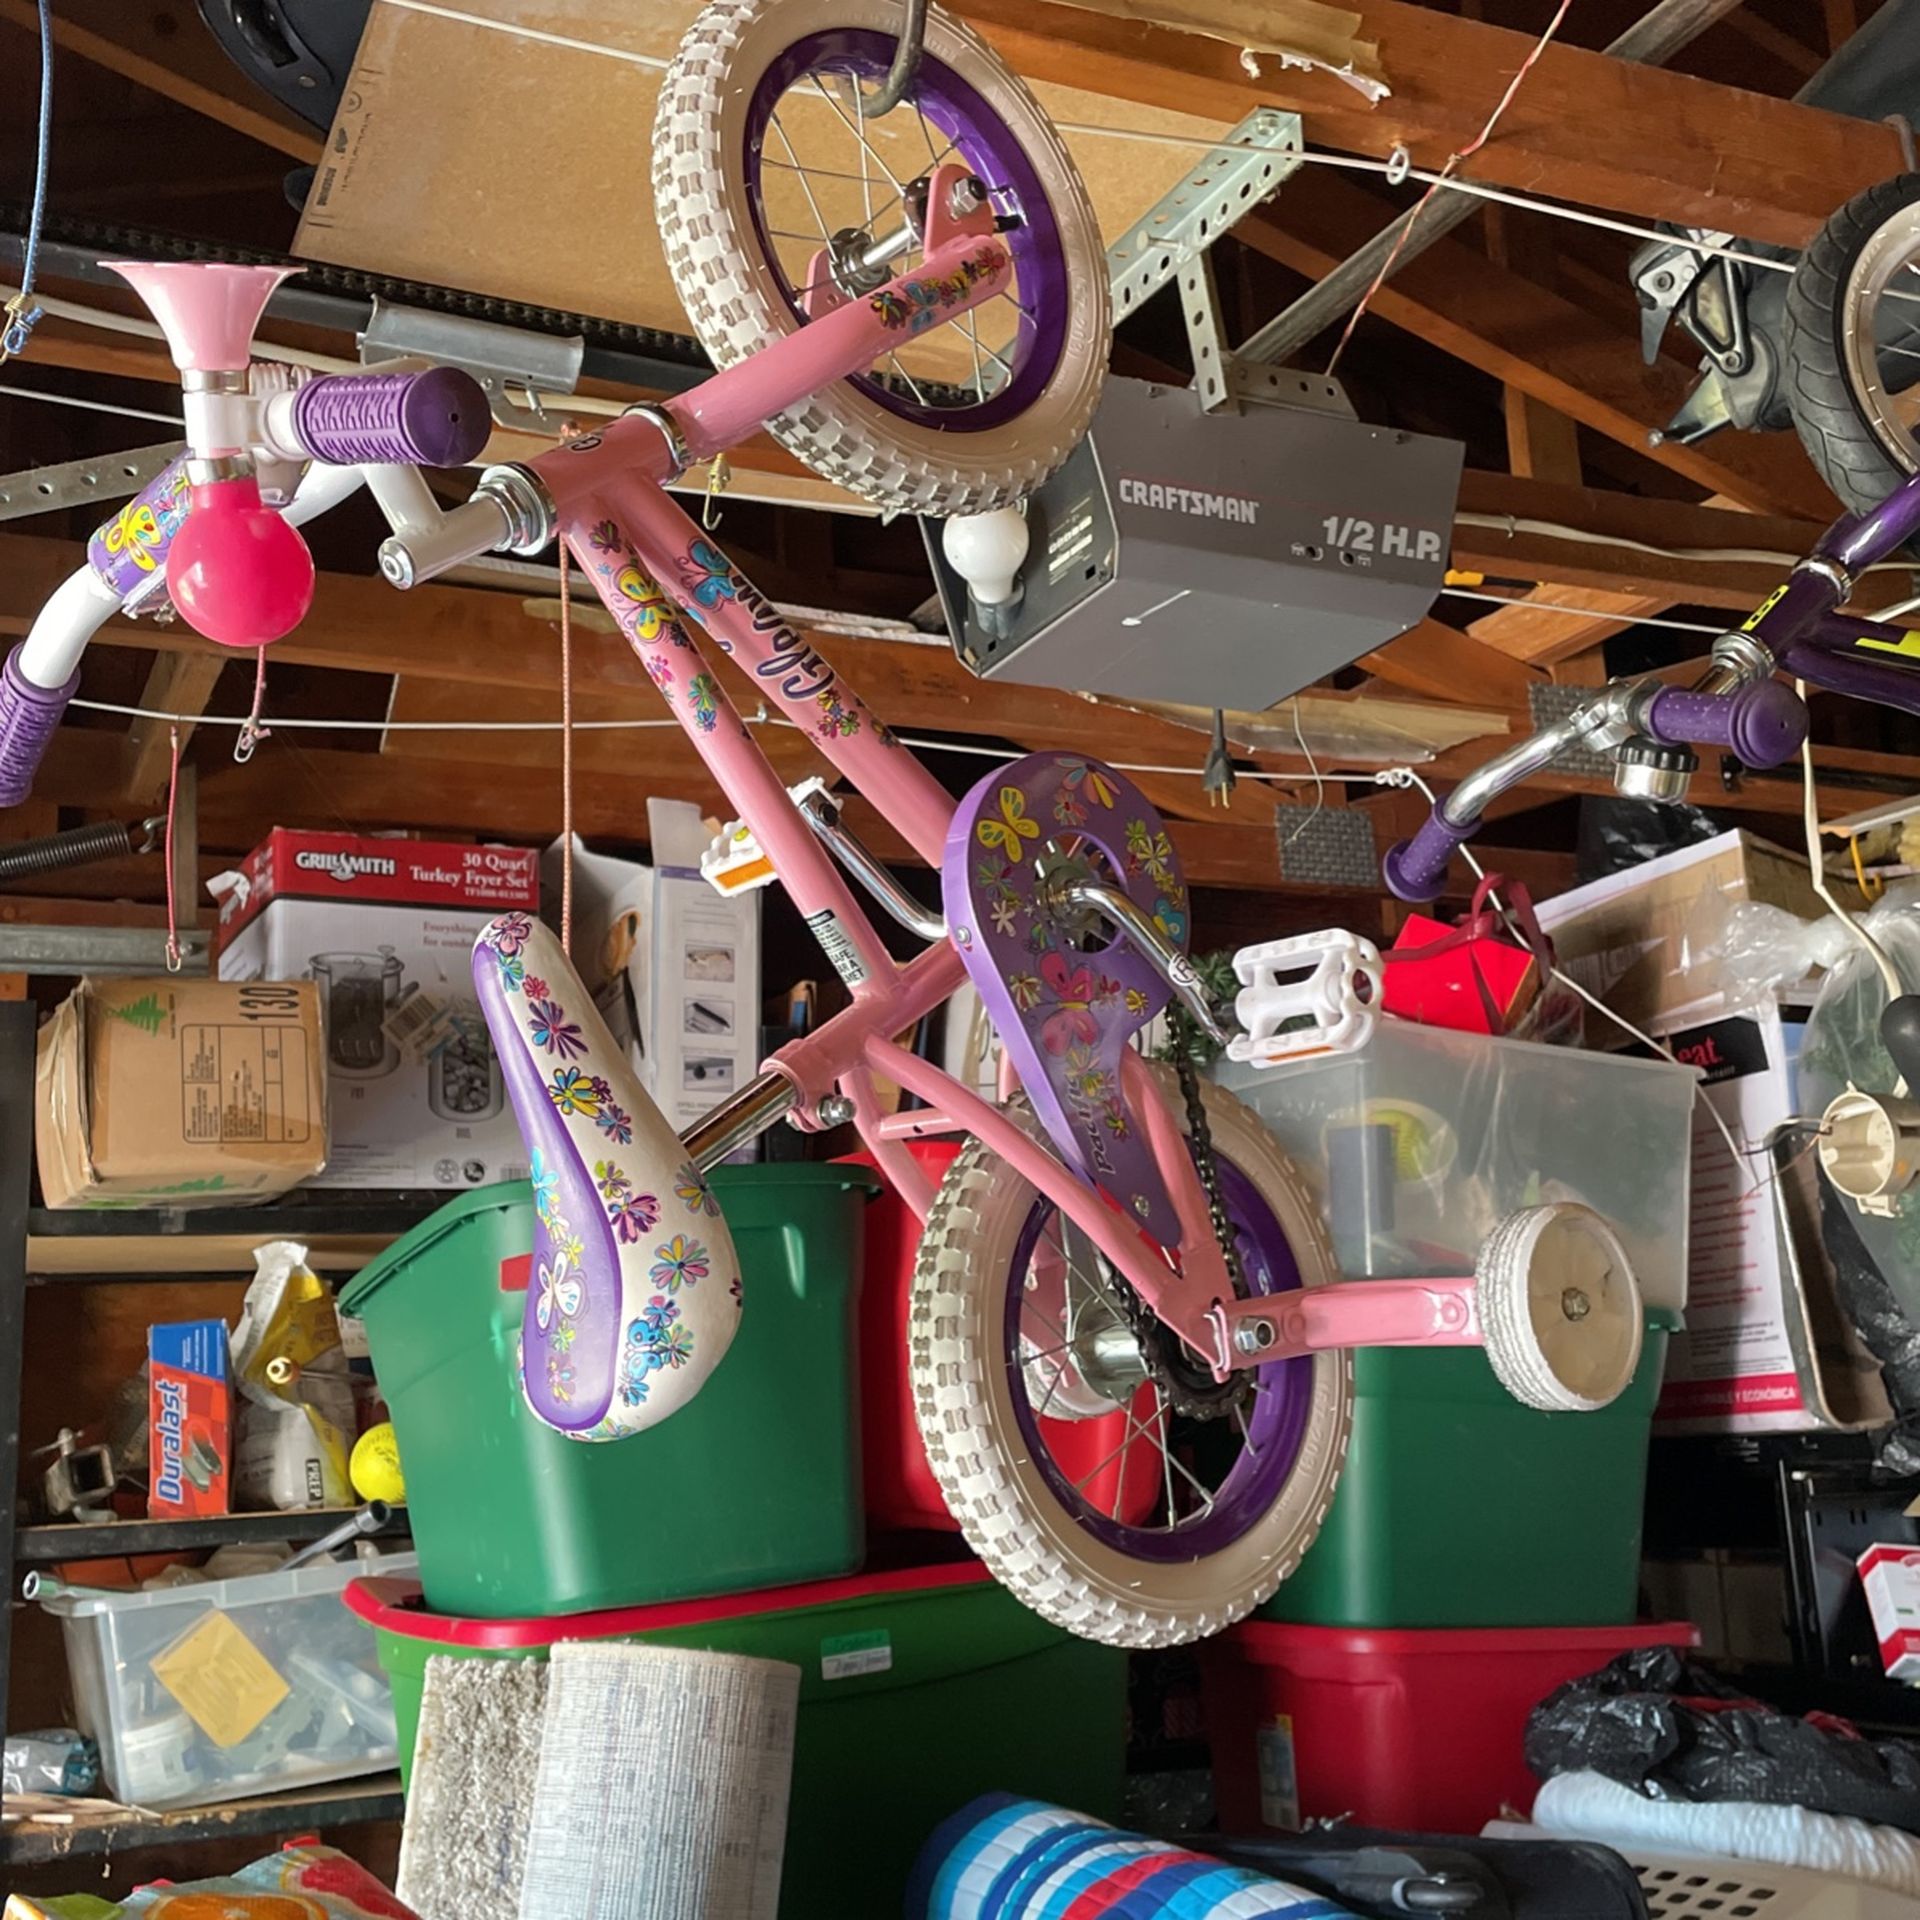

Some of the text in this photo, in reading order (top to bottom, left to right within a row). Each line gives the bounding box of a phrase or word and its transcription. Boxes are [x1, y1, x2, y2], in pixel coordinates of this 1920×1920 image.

[1119, 478, 1257, 525] CRAFTSMAN
[1322, 516, 1441, 562] 1/2 H.P.
[409, 865, 528, 890] Turkey Fryer Set
[462, 852, 528, 873] 30 Quart
[239, 986, 299, 1020] 130
[1065, 1074, 1116, 1174] Pacific
[156, 1380, 182, 1504] Duralast
[307, 1463, 321, 1499] PREP
